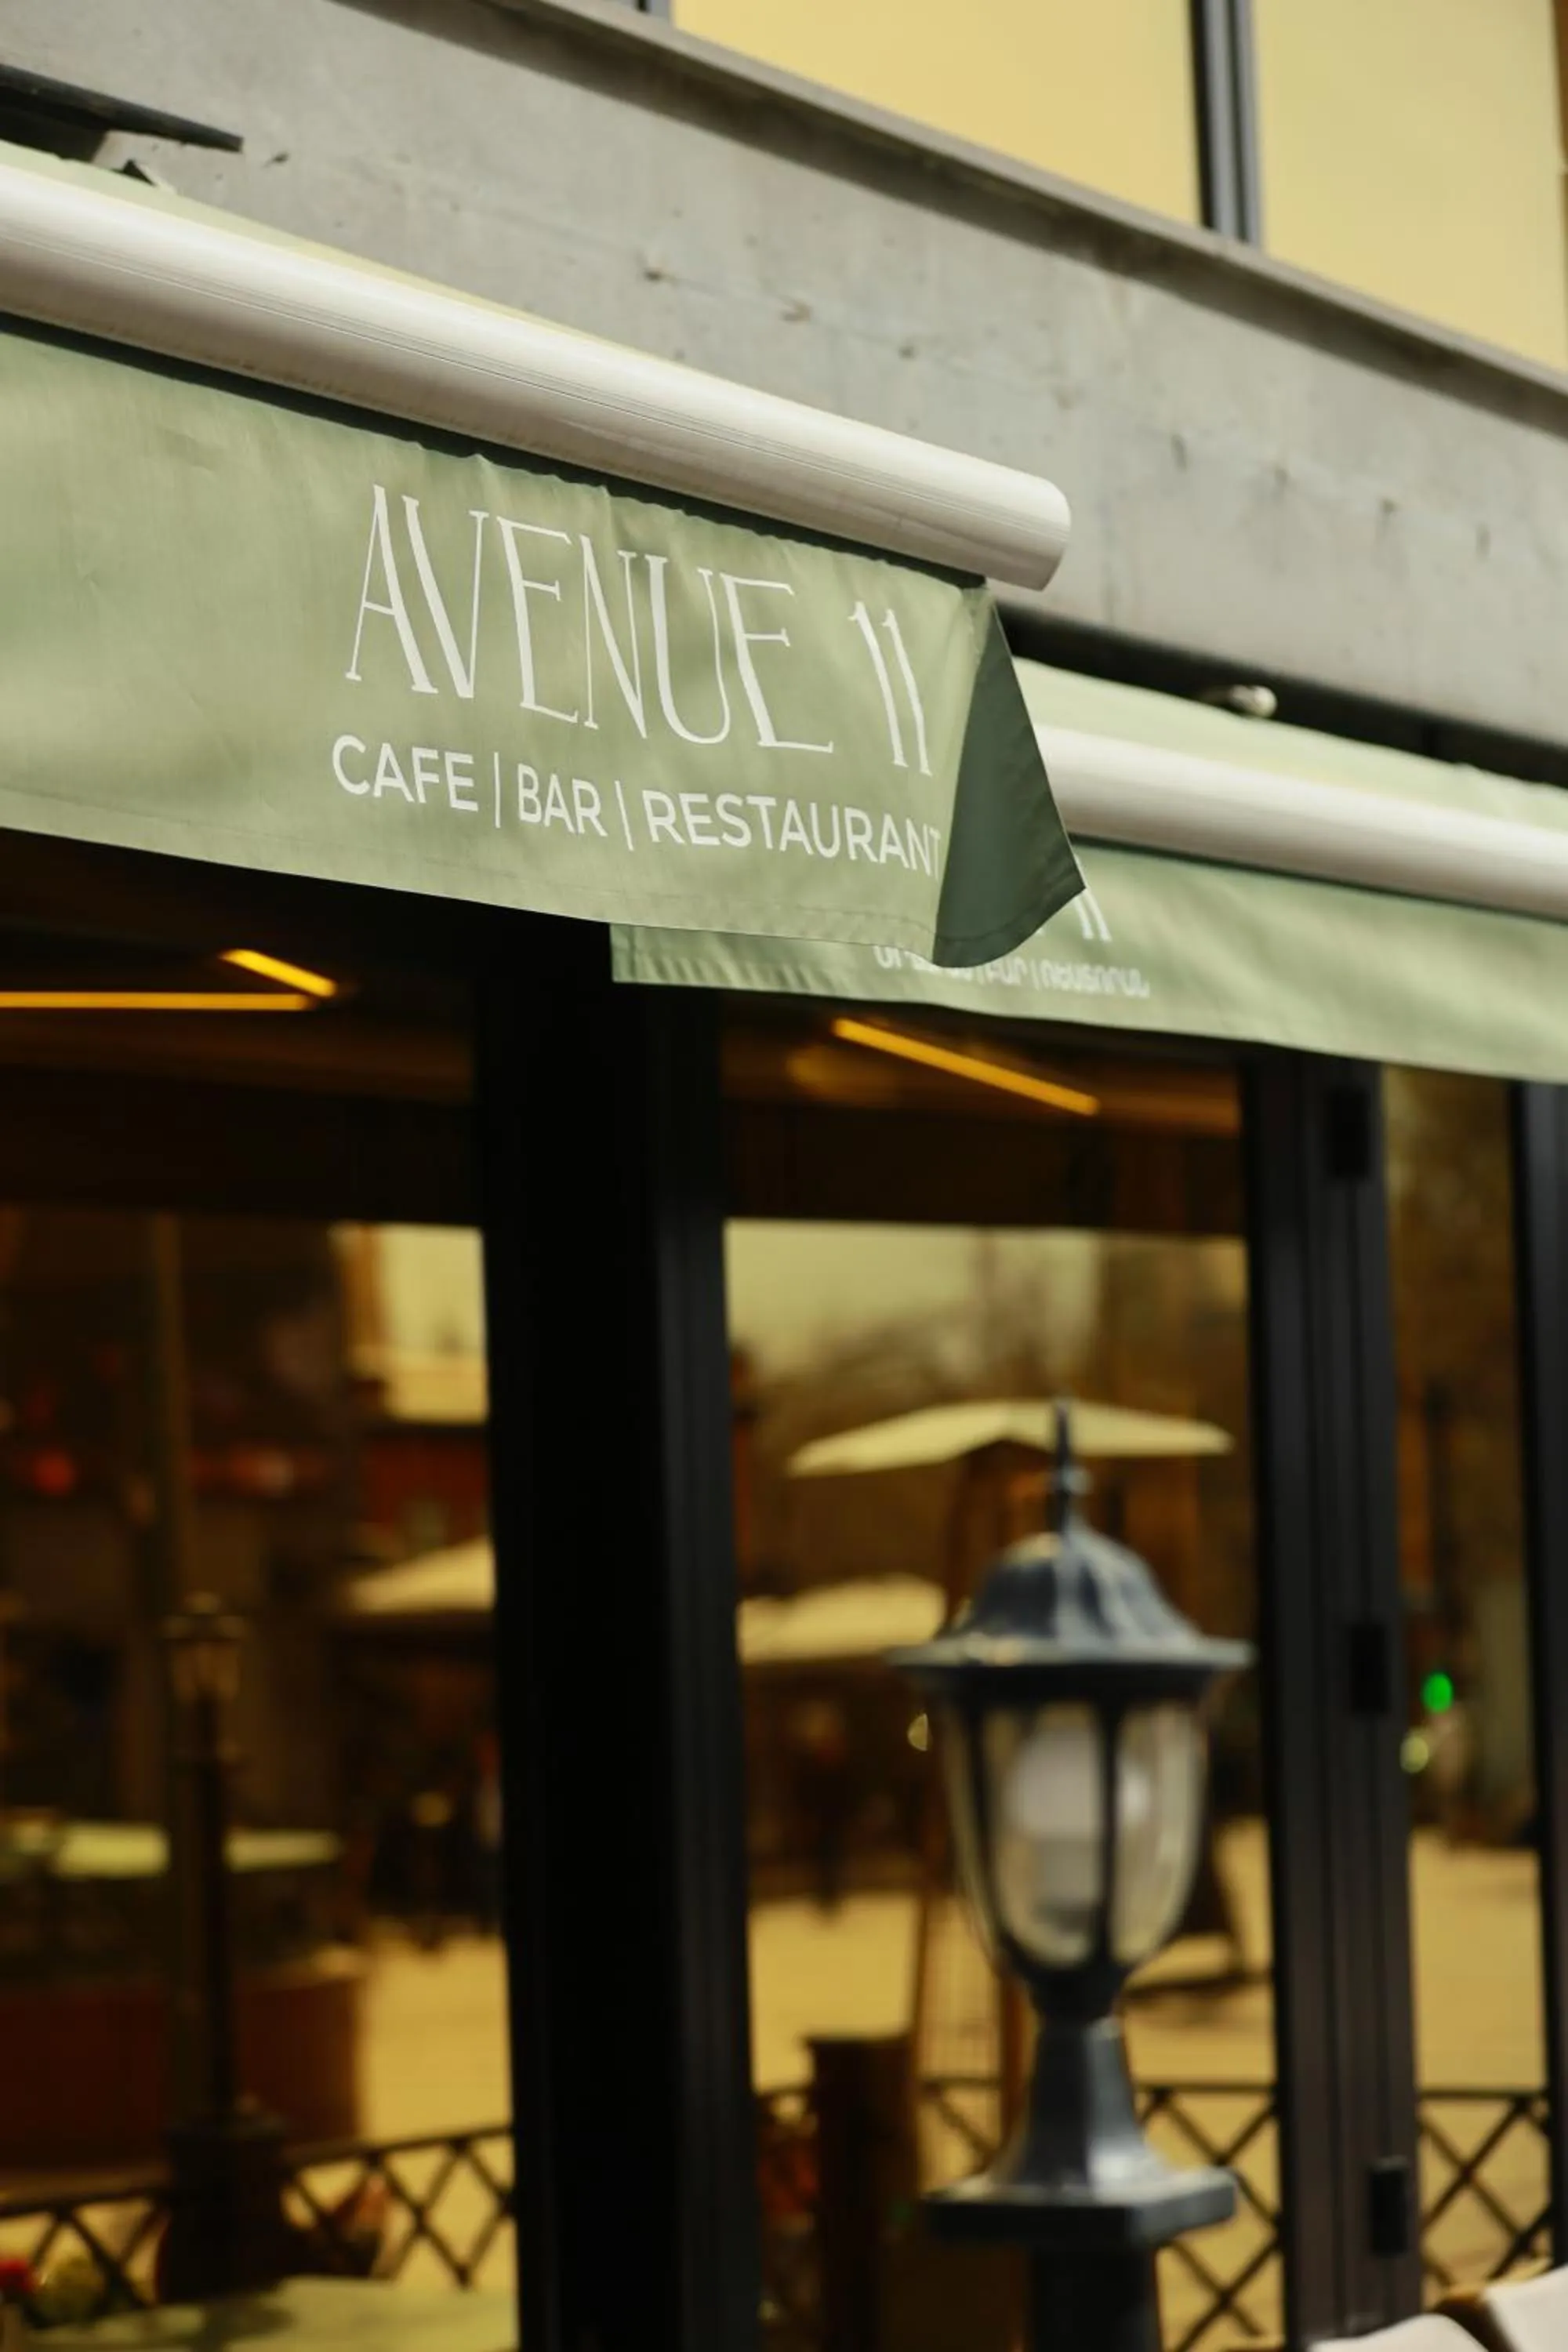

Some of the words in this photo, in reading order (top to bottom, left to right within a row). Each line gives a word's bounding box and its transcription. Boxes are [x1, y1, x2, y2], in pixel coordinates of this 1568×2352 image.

[344, 484, 834, 754] AVENUE
[848, 601, 934, 778] 11
[332, 735, 479, 812] CAFE
[517, 763, 608, 837] BAR
[641, 789, 941, 880] RESTAURANT
